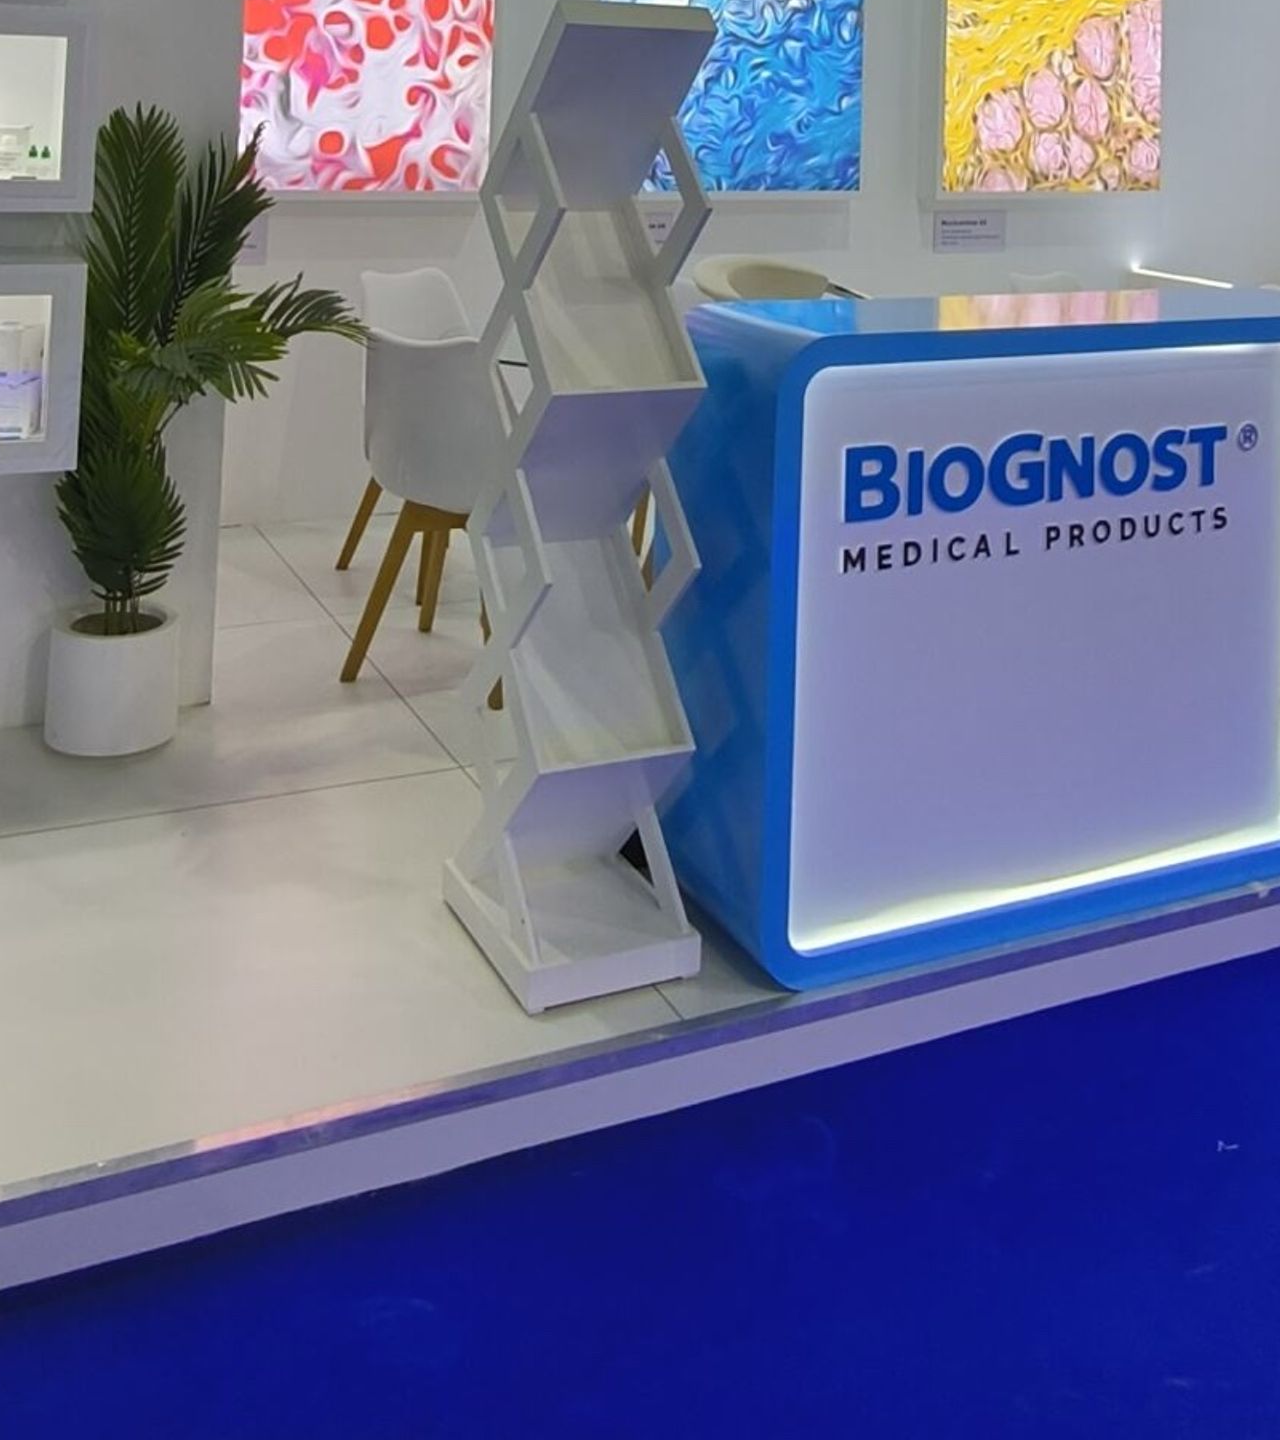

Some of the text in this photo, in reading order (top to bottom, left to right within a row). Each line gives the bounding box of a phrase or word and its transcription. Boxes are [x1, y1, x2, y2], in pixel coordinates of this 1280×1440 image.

[844, 425, 1227, 523] BIOGNOST
[842, 506, 1229, 573] MEDICAL PRODUCTS
